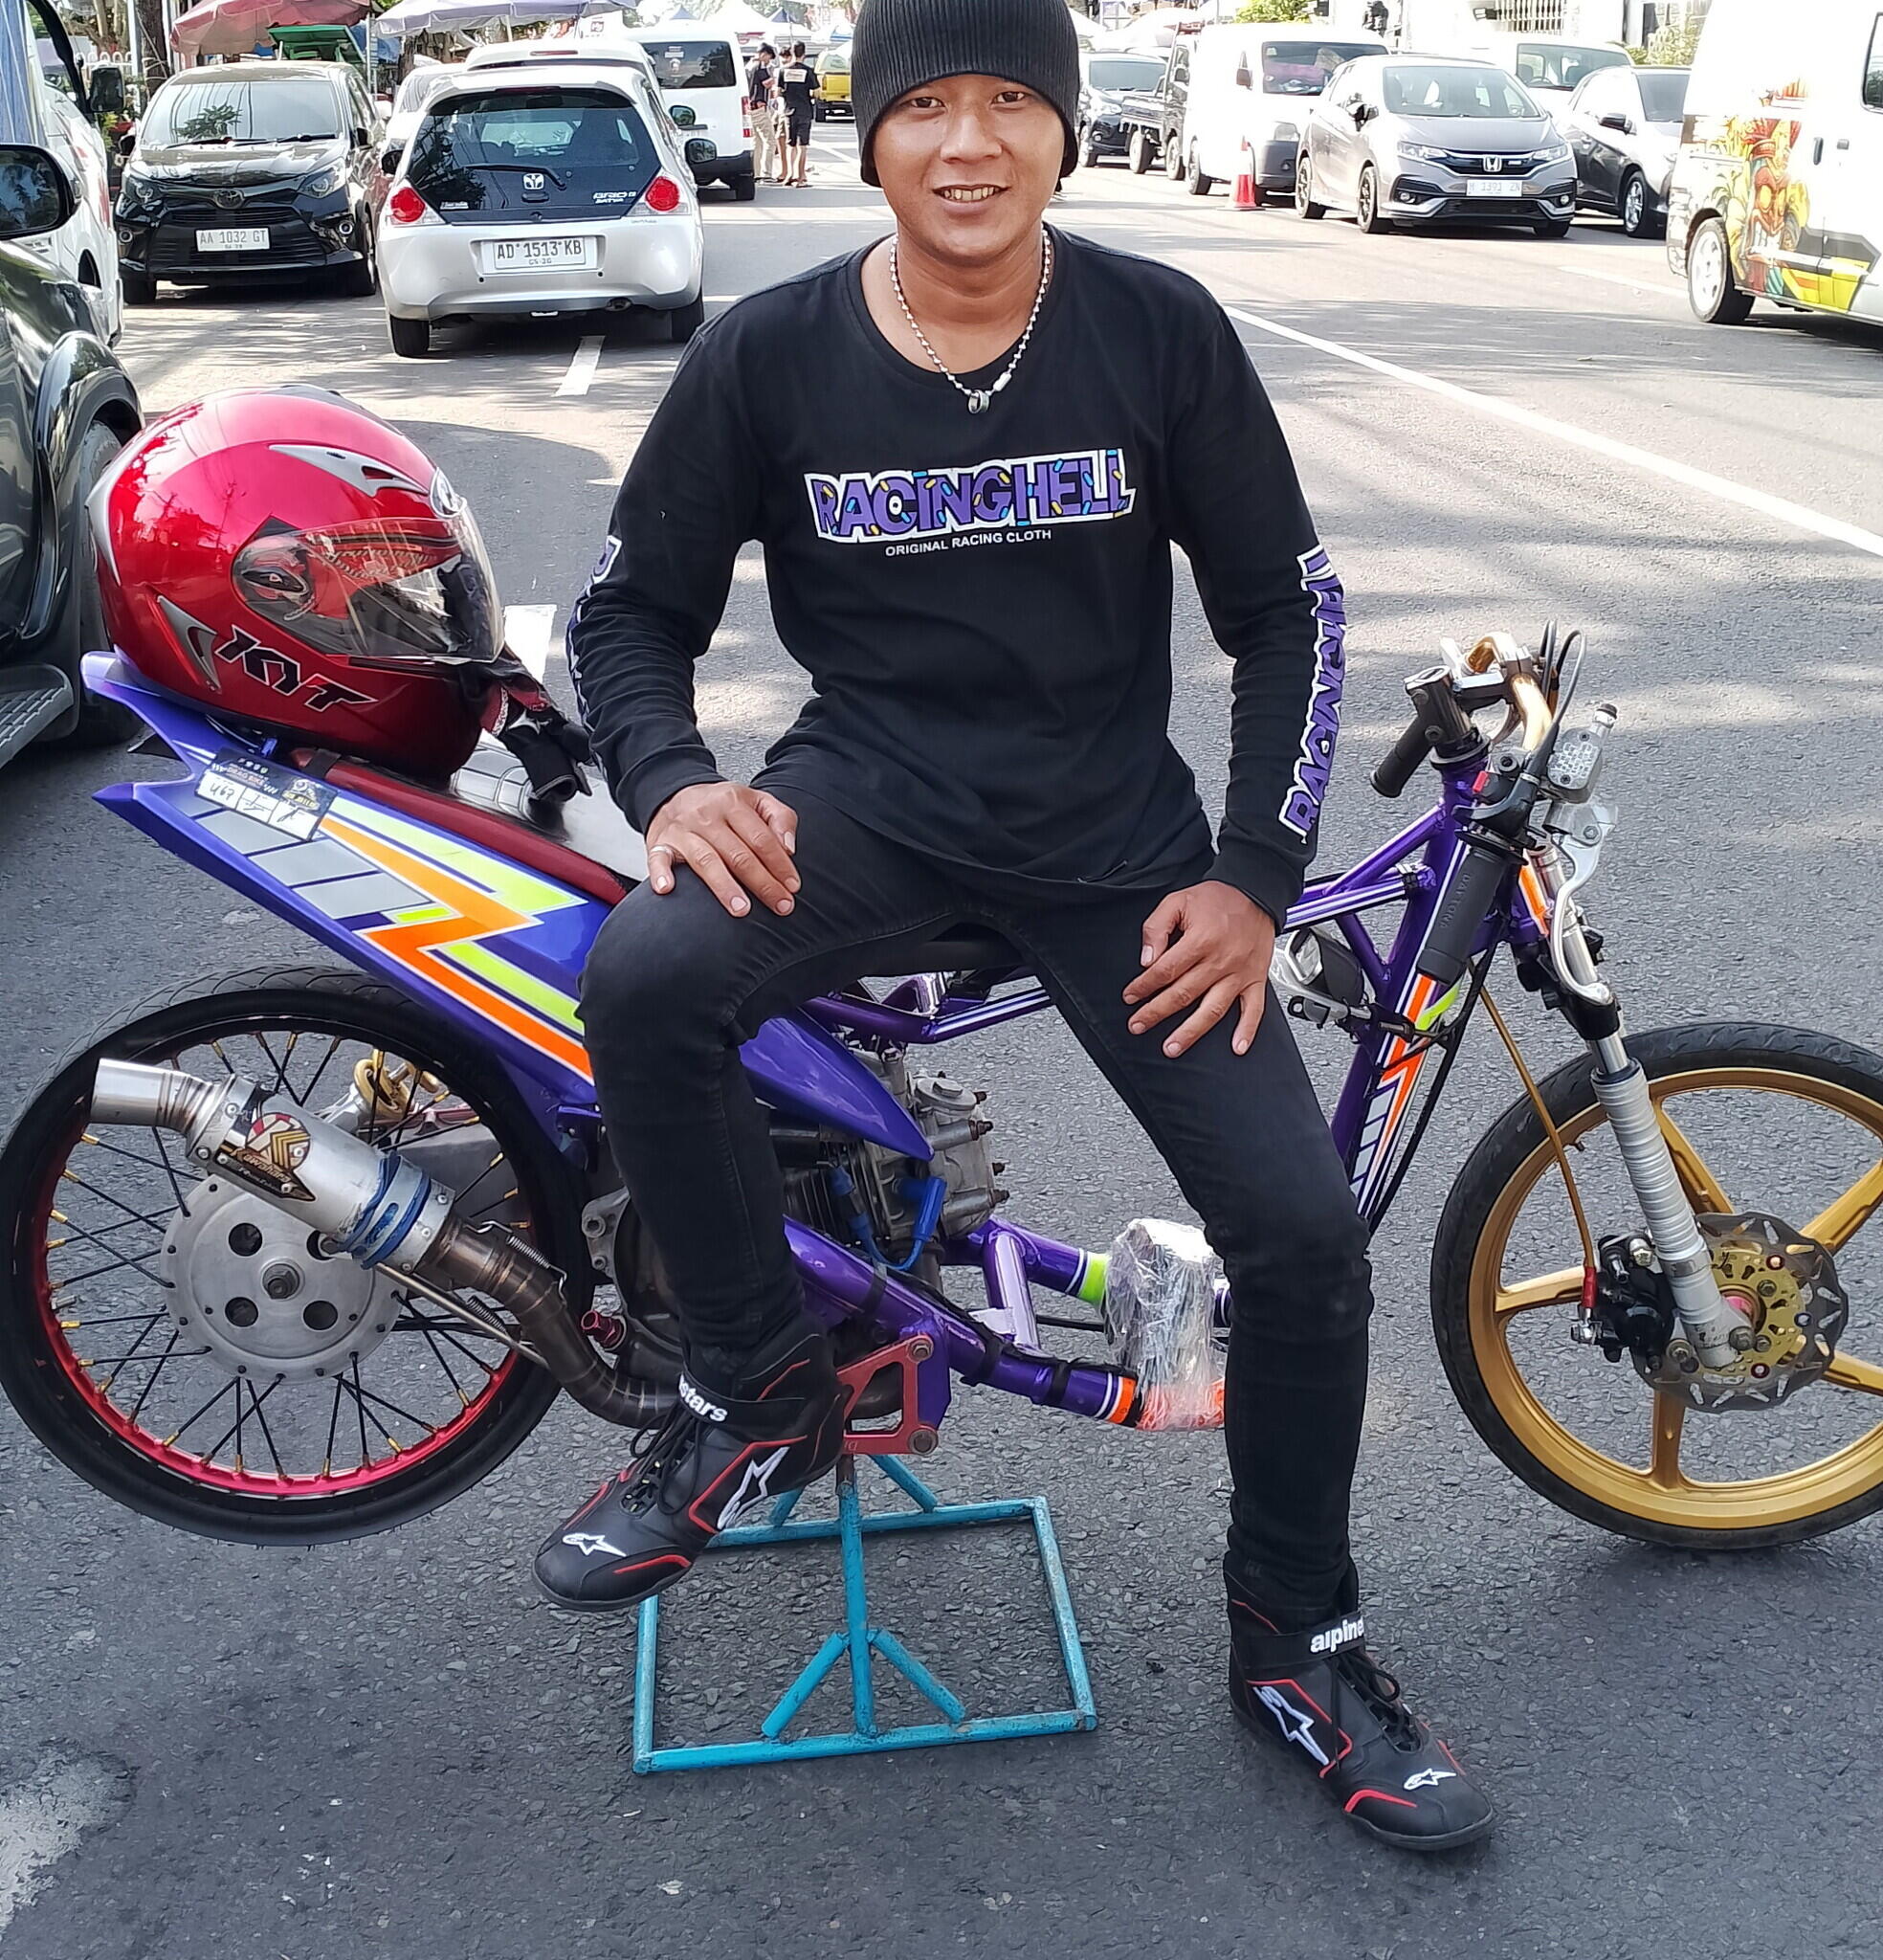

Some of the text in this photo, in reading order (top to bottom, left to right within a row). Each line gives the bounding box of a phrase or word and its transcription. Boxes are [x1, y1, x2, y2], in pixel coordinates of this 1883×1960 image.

[200, 230, 266, 244] AA 1032 GT
[498, 239, 582, 259] AD 1513 KB
[804, 448, 1137, 544] RACINGHELL
[885, 529, 1052, 557] ORIGINAL RACING CLOTH
[214, 624, 379, 712] KYT
